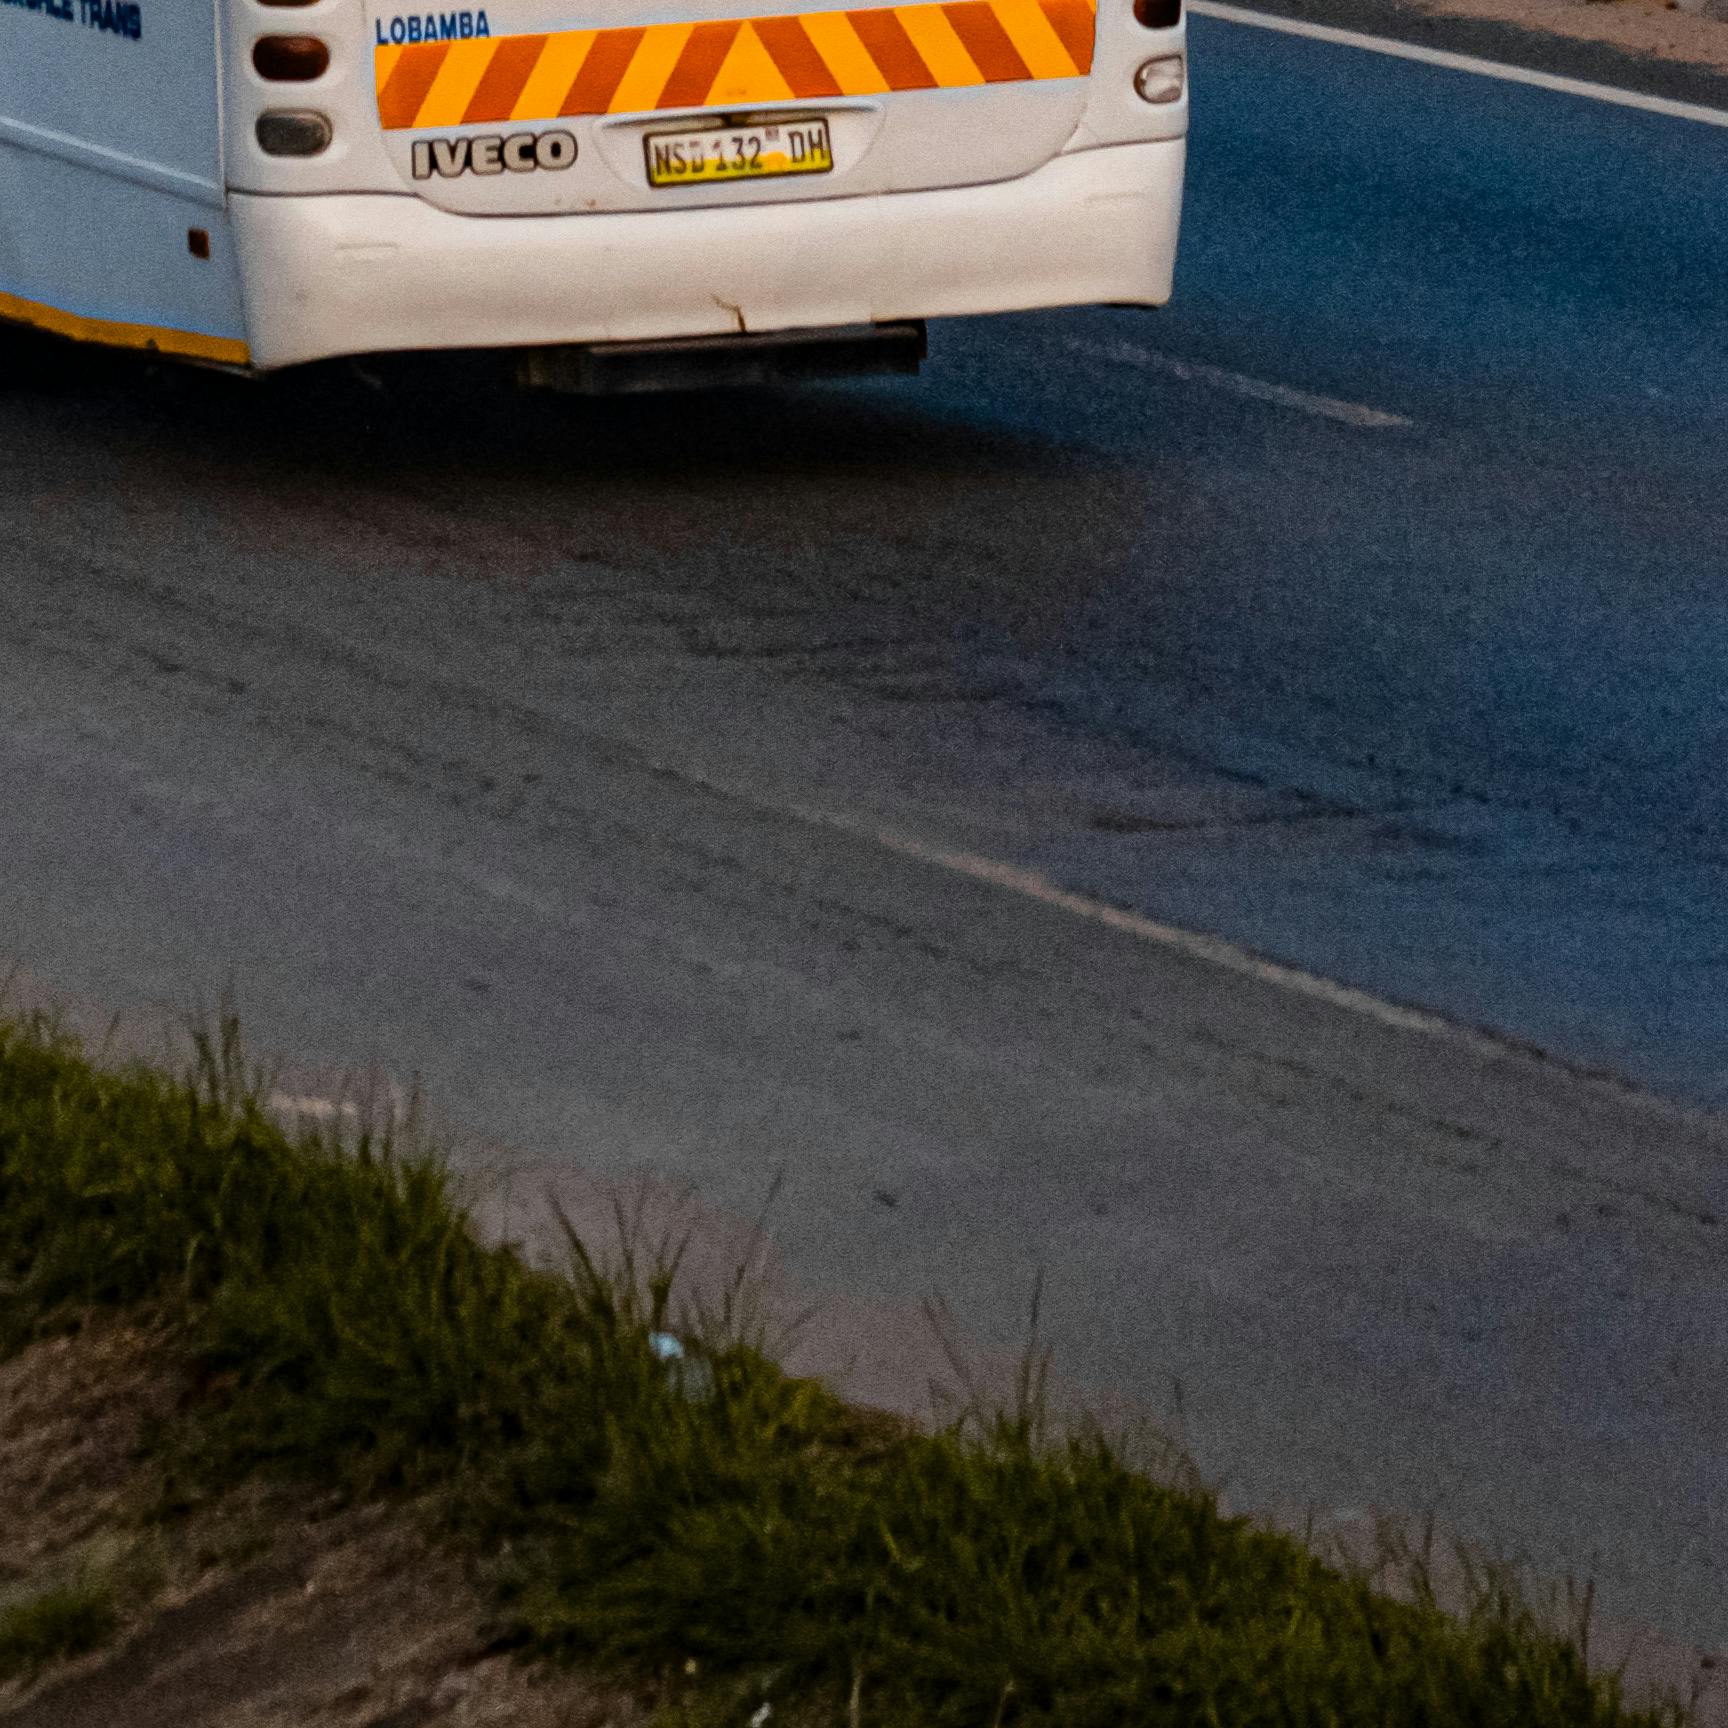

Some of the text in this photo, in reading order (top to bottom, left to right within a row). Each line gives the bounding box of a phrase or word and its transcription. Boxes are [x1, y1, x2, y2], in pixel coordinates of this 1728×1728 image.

[376, 8, 490, 45] LOBAMBA
[412, 129, 578, 180] IVECO
[712, 135, 763, 171] 132
[788, 128, 825, 163] DH
